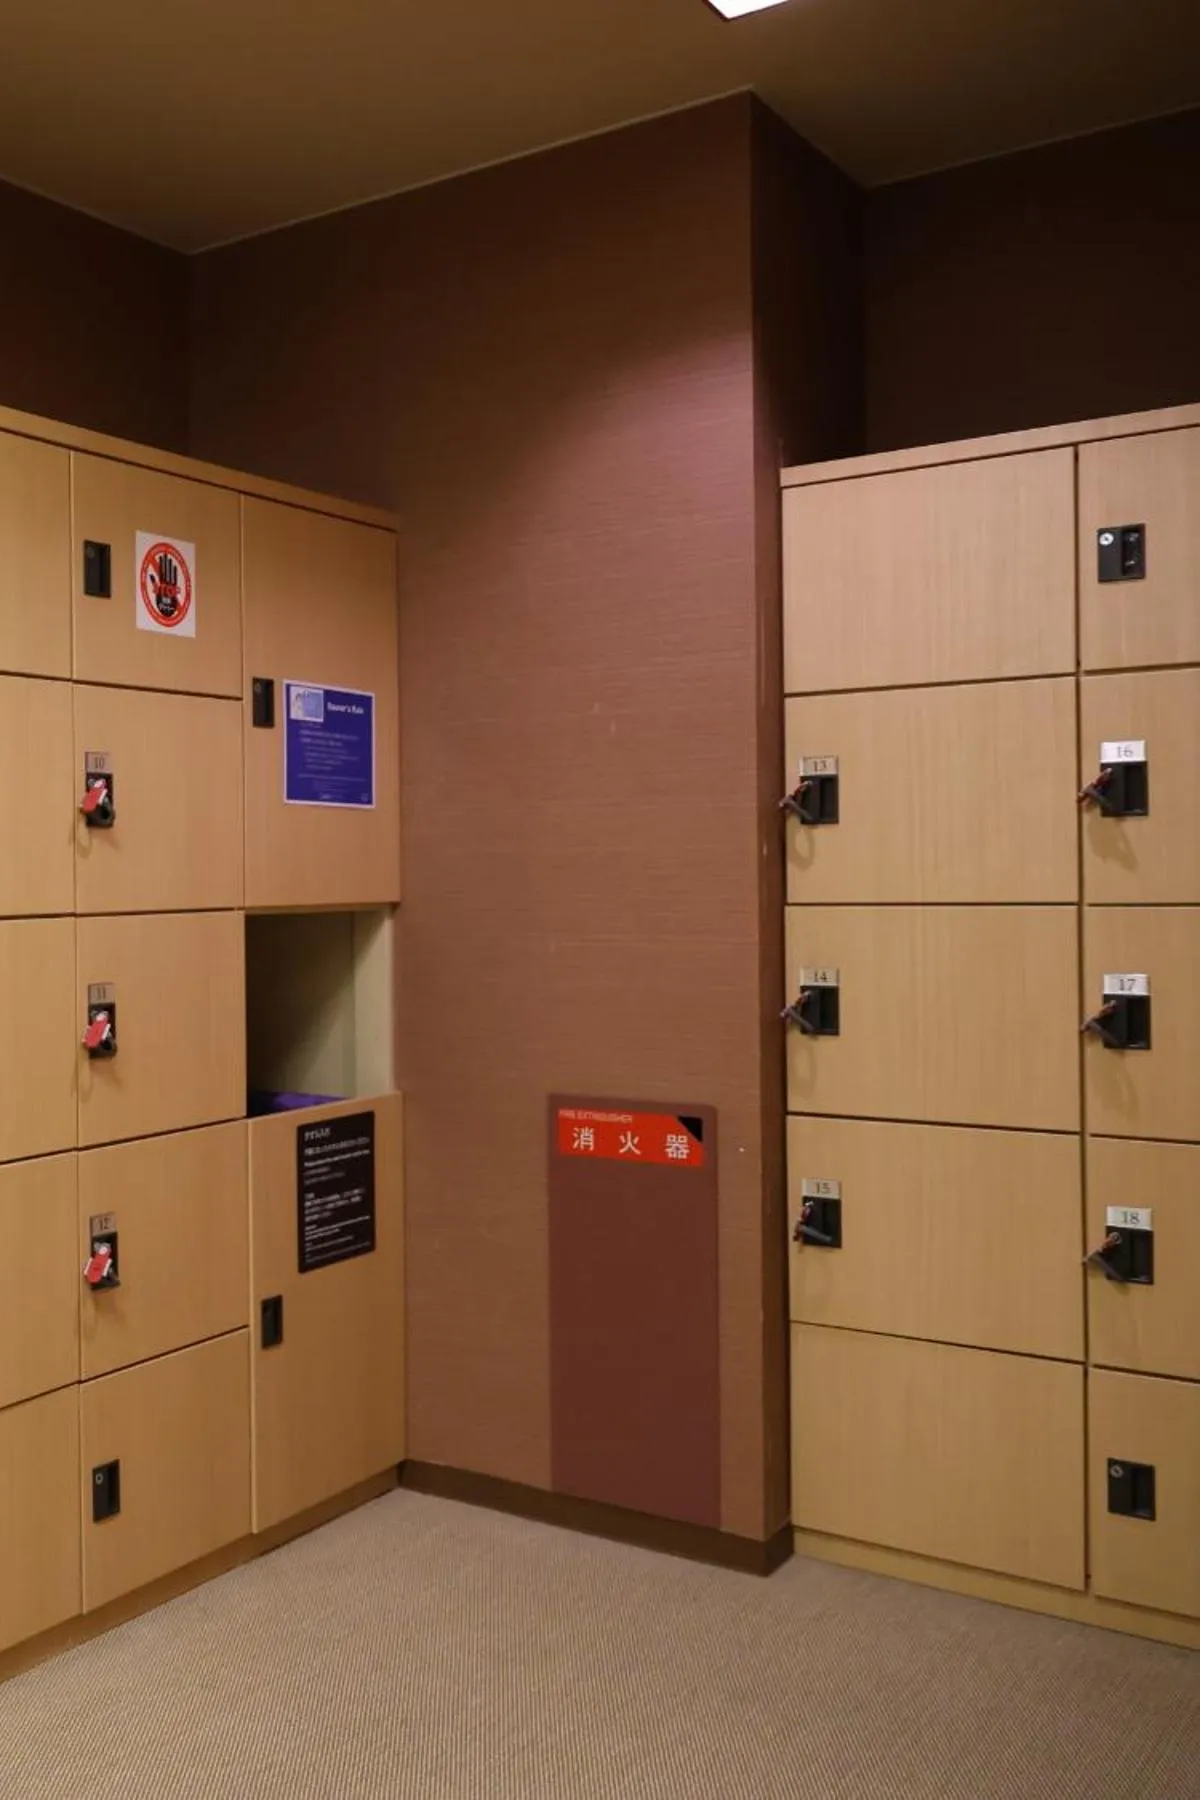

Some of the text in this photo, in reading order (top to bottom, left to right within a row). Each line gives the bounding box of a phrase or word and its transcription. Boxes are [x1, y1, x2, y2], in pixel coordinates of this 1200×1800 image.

[1116, 743, 1134, 758] 16
[814, 971, 827, 982] 14
[1119, 978, 1137, 991] 17
[572, 1126, 690, 1160] 消火器
[1123, 1211, 1140, 1225] 18
